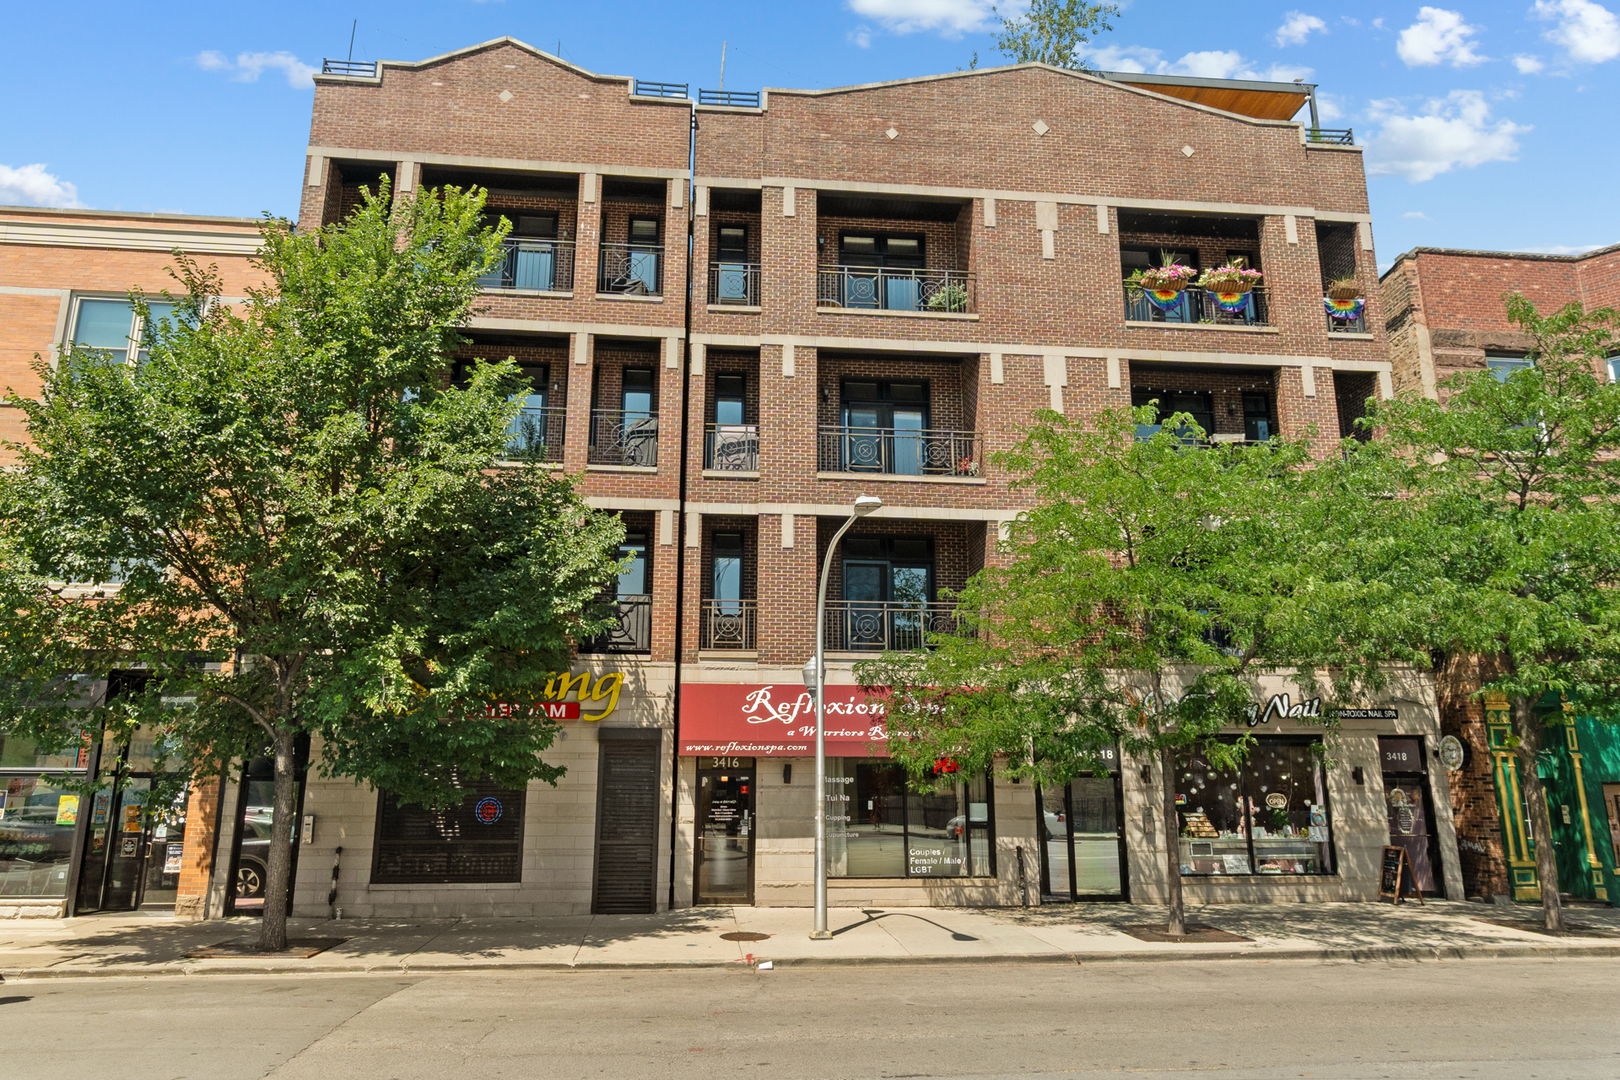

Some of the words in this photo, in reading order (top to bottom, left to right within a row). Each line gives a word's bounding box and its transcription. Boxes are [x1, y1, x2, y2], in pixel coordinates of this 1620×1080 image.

[741, 685, 885, 724] Reflxion
[1262, 693, 1320, 723] Nail
[1368, 709, 1384, 718] NAIL
[1384, 709, 1398, 718] SPA
[798, 725, 865, 737] Wrriors
[685, 741, 808, 755] www.reflexionspa.com
[1386, 752, 1408, 761] 3418
[712, 757, 740, 768] 3416
[933, 757, 960, 774] PEN
[826, 794, 838, 802] Tui
[839, 794, 850, 802] Na
[825, 814, 851, 822] Cupping
[909, 848, 941, 857] Couples
[910, 857, 938, 865] Female
[943, 857, 962, 865] Male
[910, 866, 933, 874] LGBT
